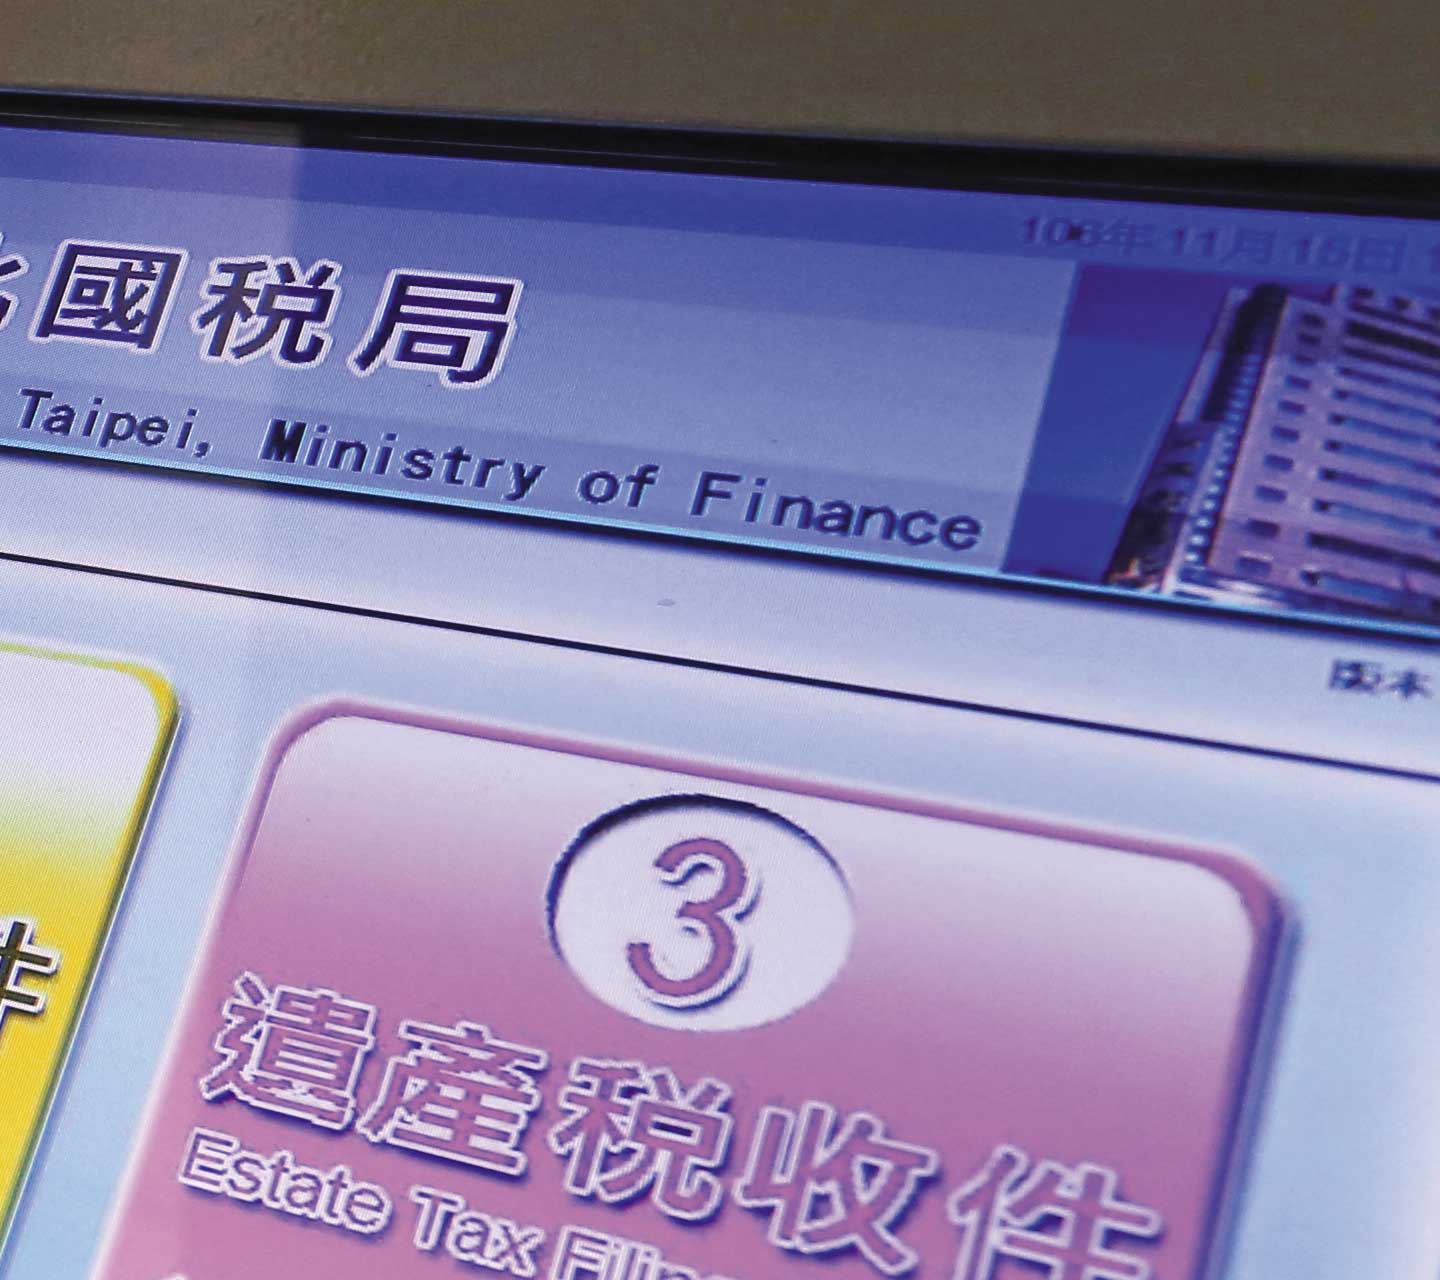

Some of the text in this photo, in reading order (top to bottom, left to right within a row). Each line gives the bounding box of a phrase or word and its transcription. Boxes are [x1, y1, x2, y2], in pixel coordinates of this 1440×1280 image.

[18, 387, 212, 458] Taipei,
[260, 417, 544, 501] Ministry
[580, 464, 661, 509] of
[691, 470, 983, 551] Finance
[625, 834, 755, 1008] 3
[178, 1127, 392, 1238] Estate
